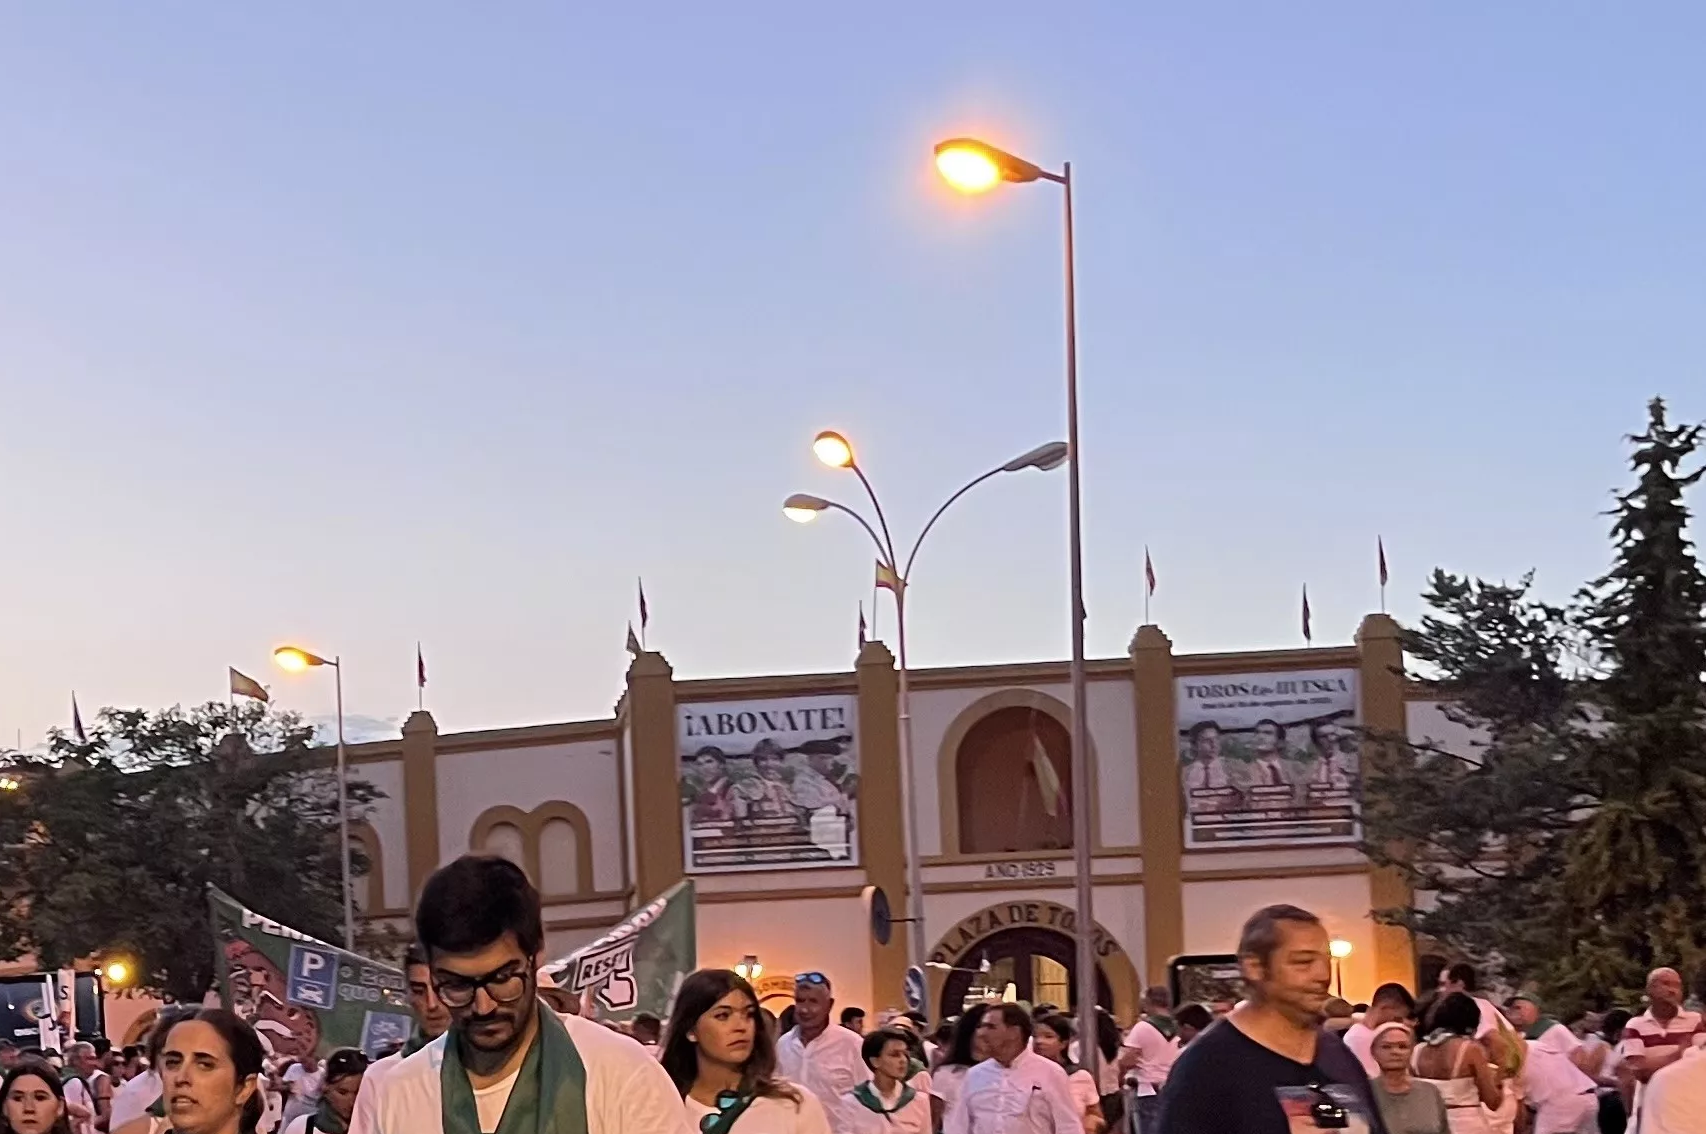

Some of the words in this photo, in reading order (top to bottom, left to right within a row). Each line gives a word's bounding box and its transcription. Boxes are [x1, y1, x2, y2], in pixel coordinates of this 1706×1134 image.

[1186, 683, 1249, 698] TOROS
[1276, 679, 1347, 695] HUESCA
[931, 909, 1003, 963] PLAZA
[1007, 904, 1039, 923] DE
[301, 952, 325, 978] P
